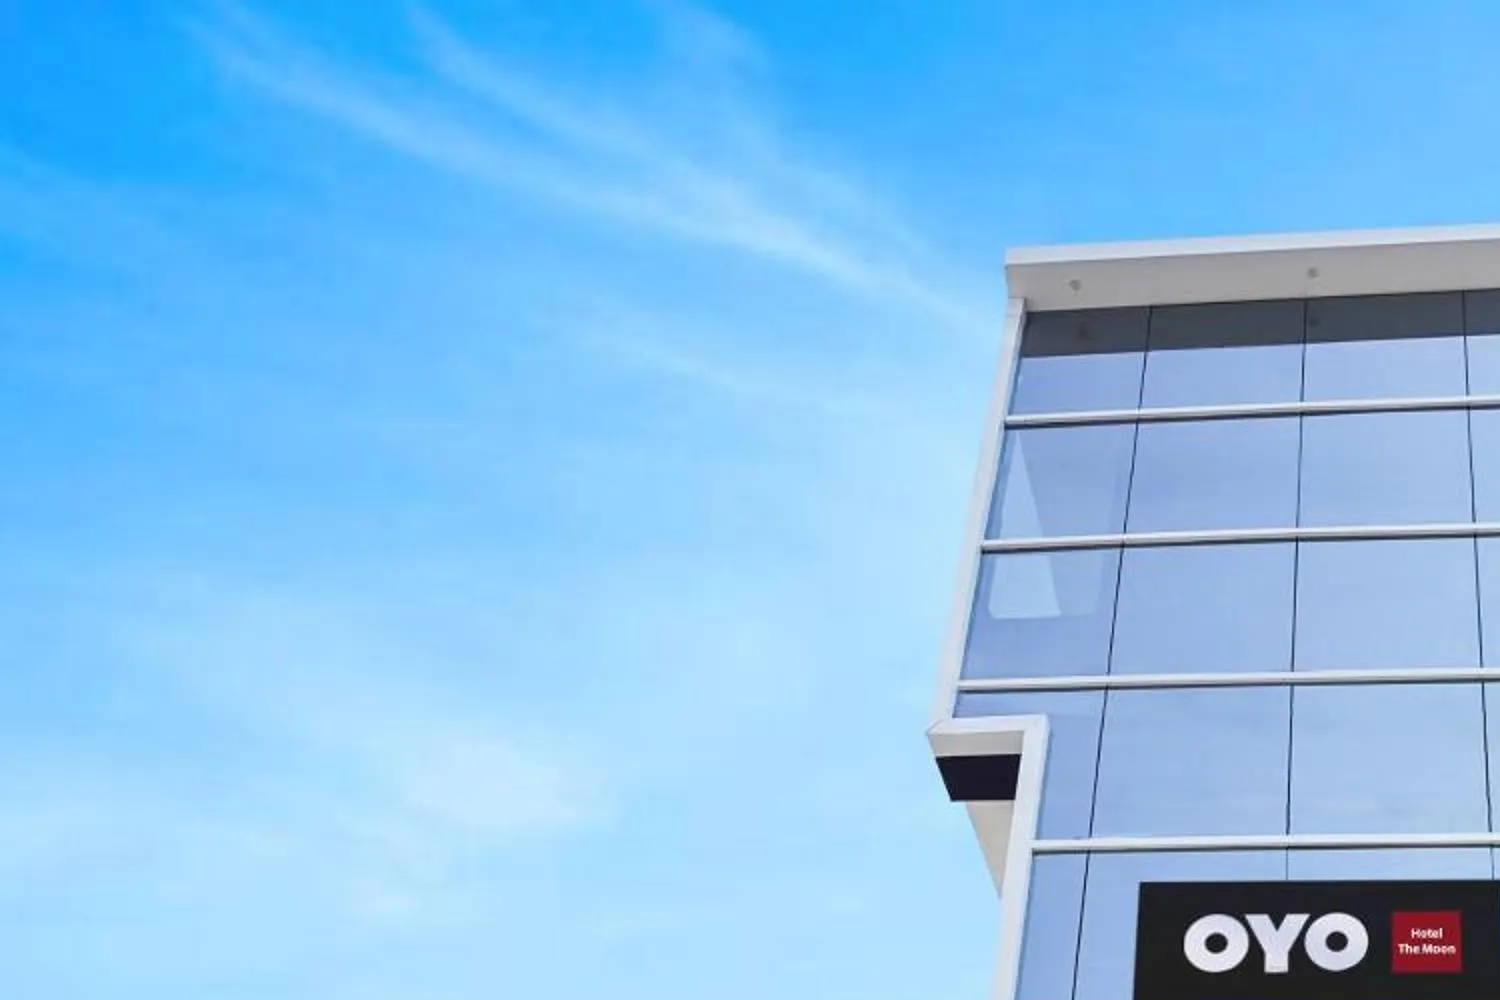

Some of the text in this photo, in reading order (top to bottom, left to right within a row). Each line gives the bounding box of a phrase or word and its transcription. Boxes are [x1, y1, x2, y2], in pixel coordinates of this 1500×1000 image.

[1410, 927, 1443, 939] Hotel
[1183, 911, 1369, 974] OYO
[1398, 943, 1457, 955] The Moon
